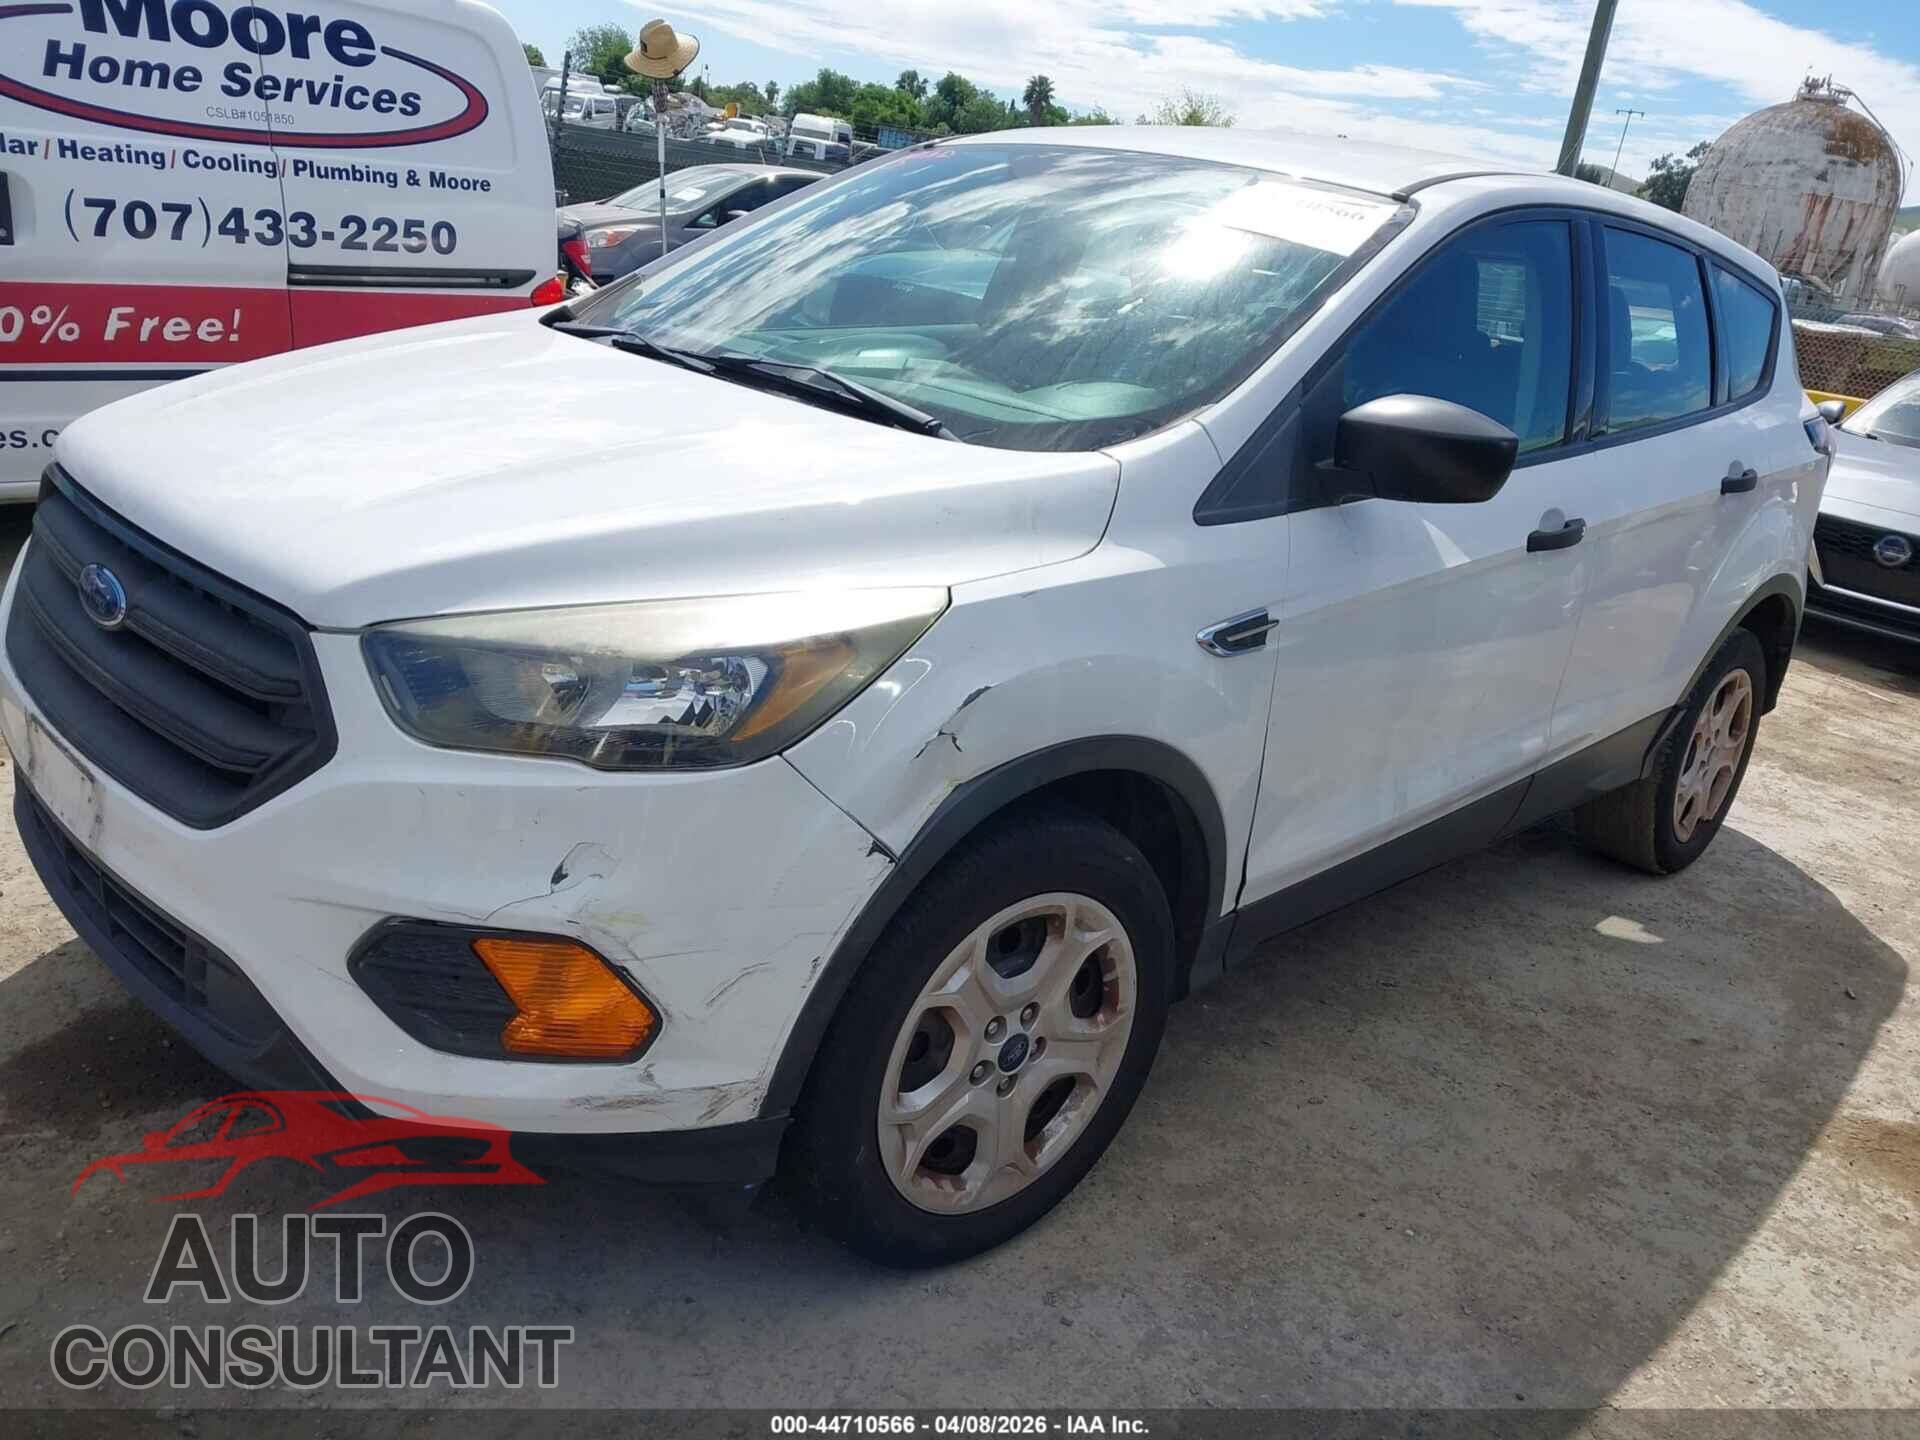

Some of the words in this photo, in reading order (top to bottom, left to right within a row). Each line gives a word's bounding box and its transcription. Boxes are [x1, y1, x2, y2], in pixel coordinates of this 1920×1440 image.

[77, 0, 377, 67] Moore
[43, 38, 203, 92] Home
[220, 61, 422, 117] Services
[406, 170, 421, 187] &
[429, 171, 491, 192] Moore
[104, 307, 240, 342] Free!
